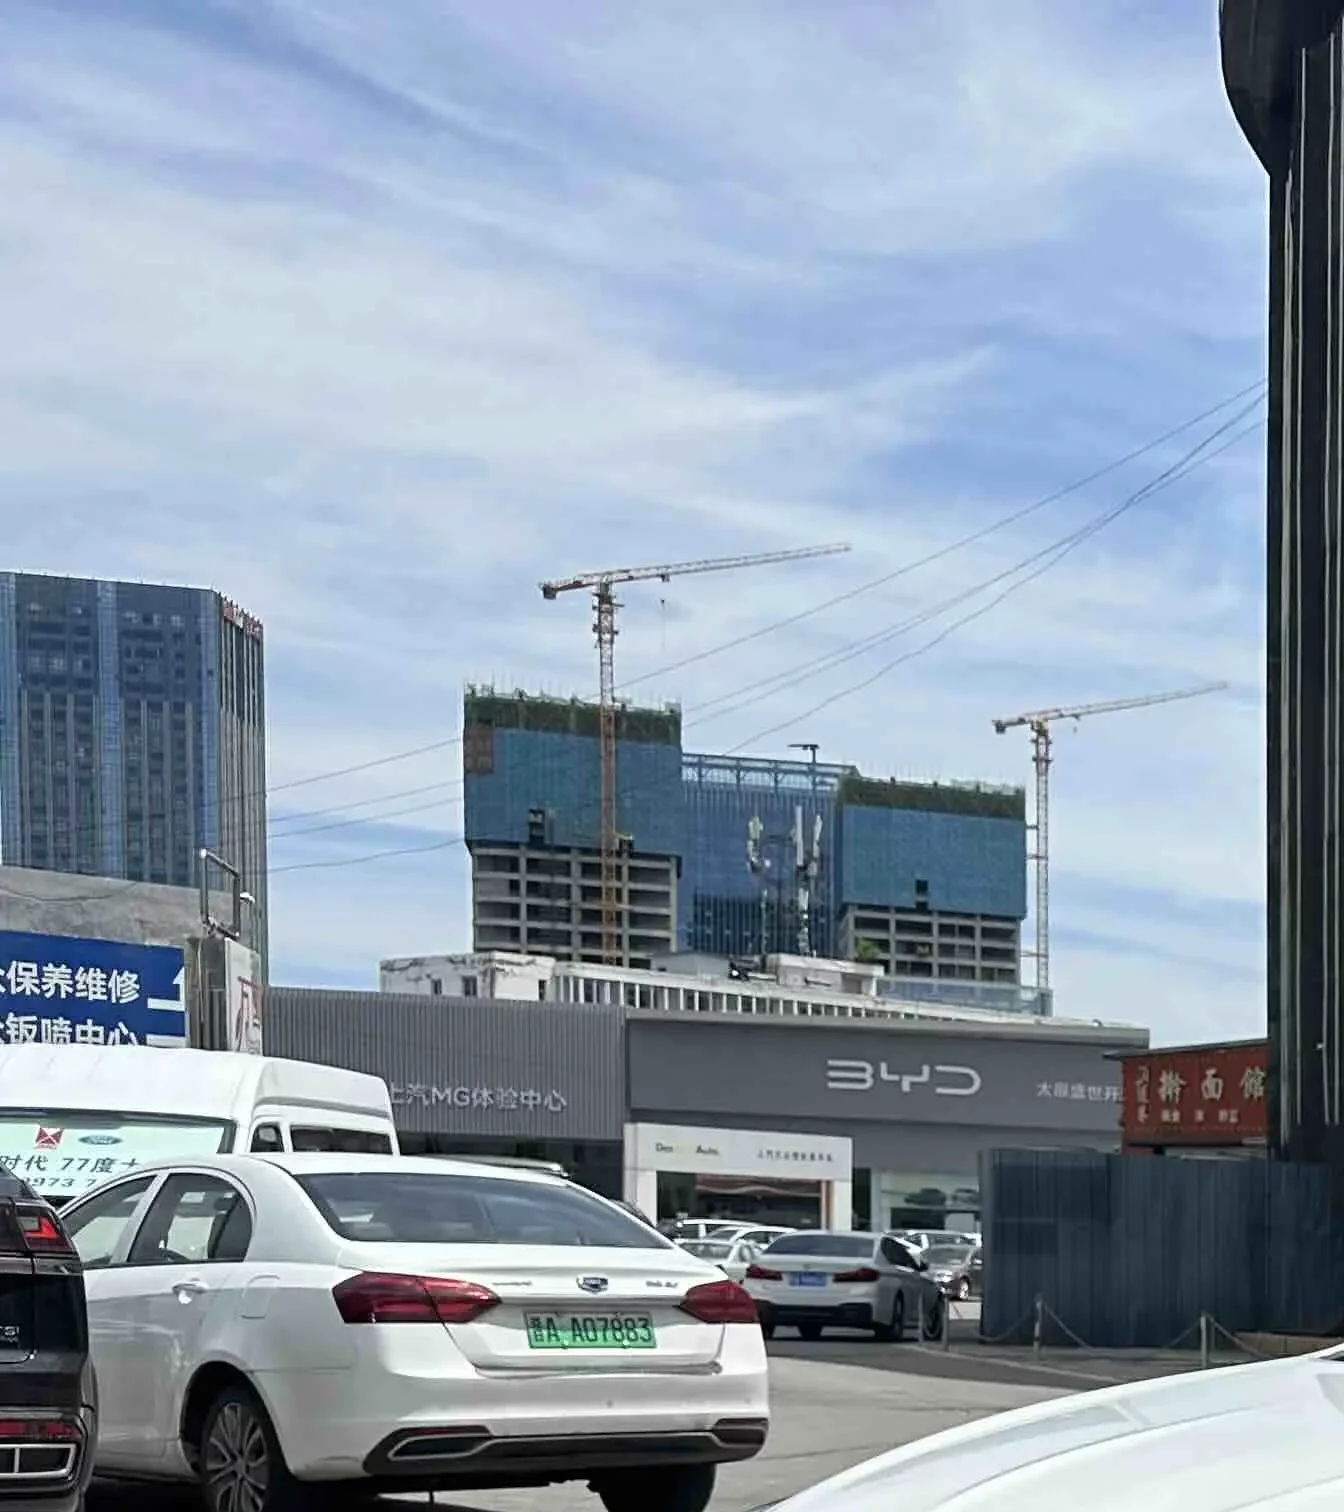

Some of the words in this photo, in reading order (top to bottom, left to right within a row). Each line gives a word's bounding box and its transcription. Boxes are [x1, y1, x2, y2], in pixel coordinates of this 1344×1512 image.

[0, 959, 140, 1004] 保养维修
[0, 1012, 139, 1046] 钣喷中心
[826, 1058, 982, 1096] BYD
[1036, 1081, 1123, 1102] 太原盛世开
